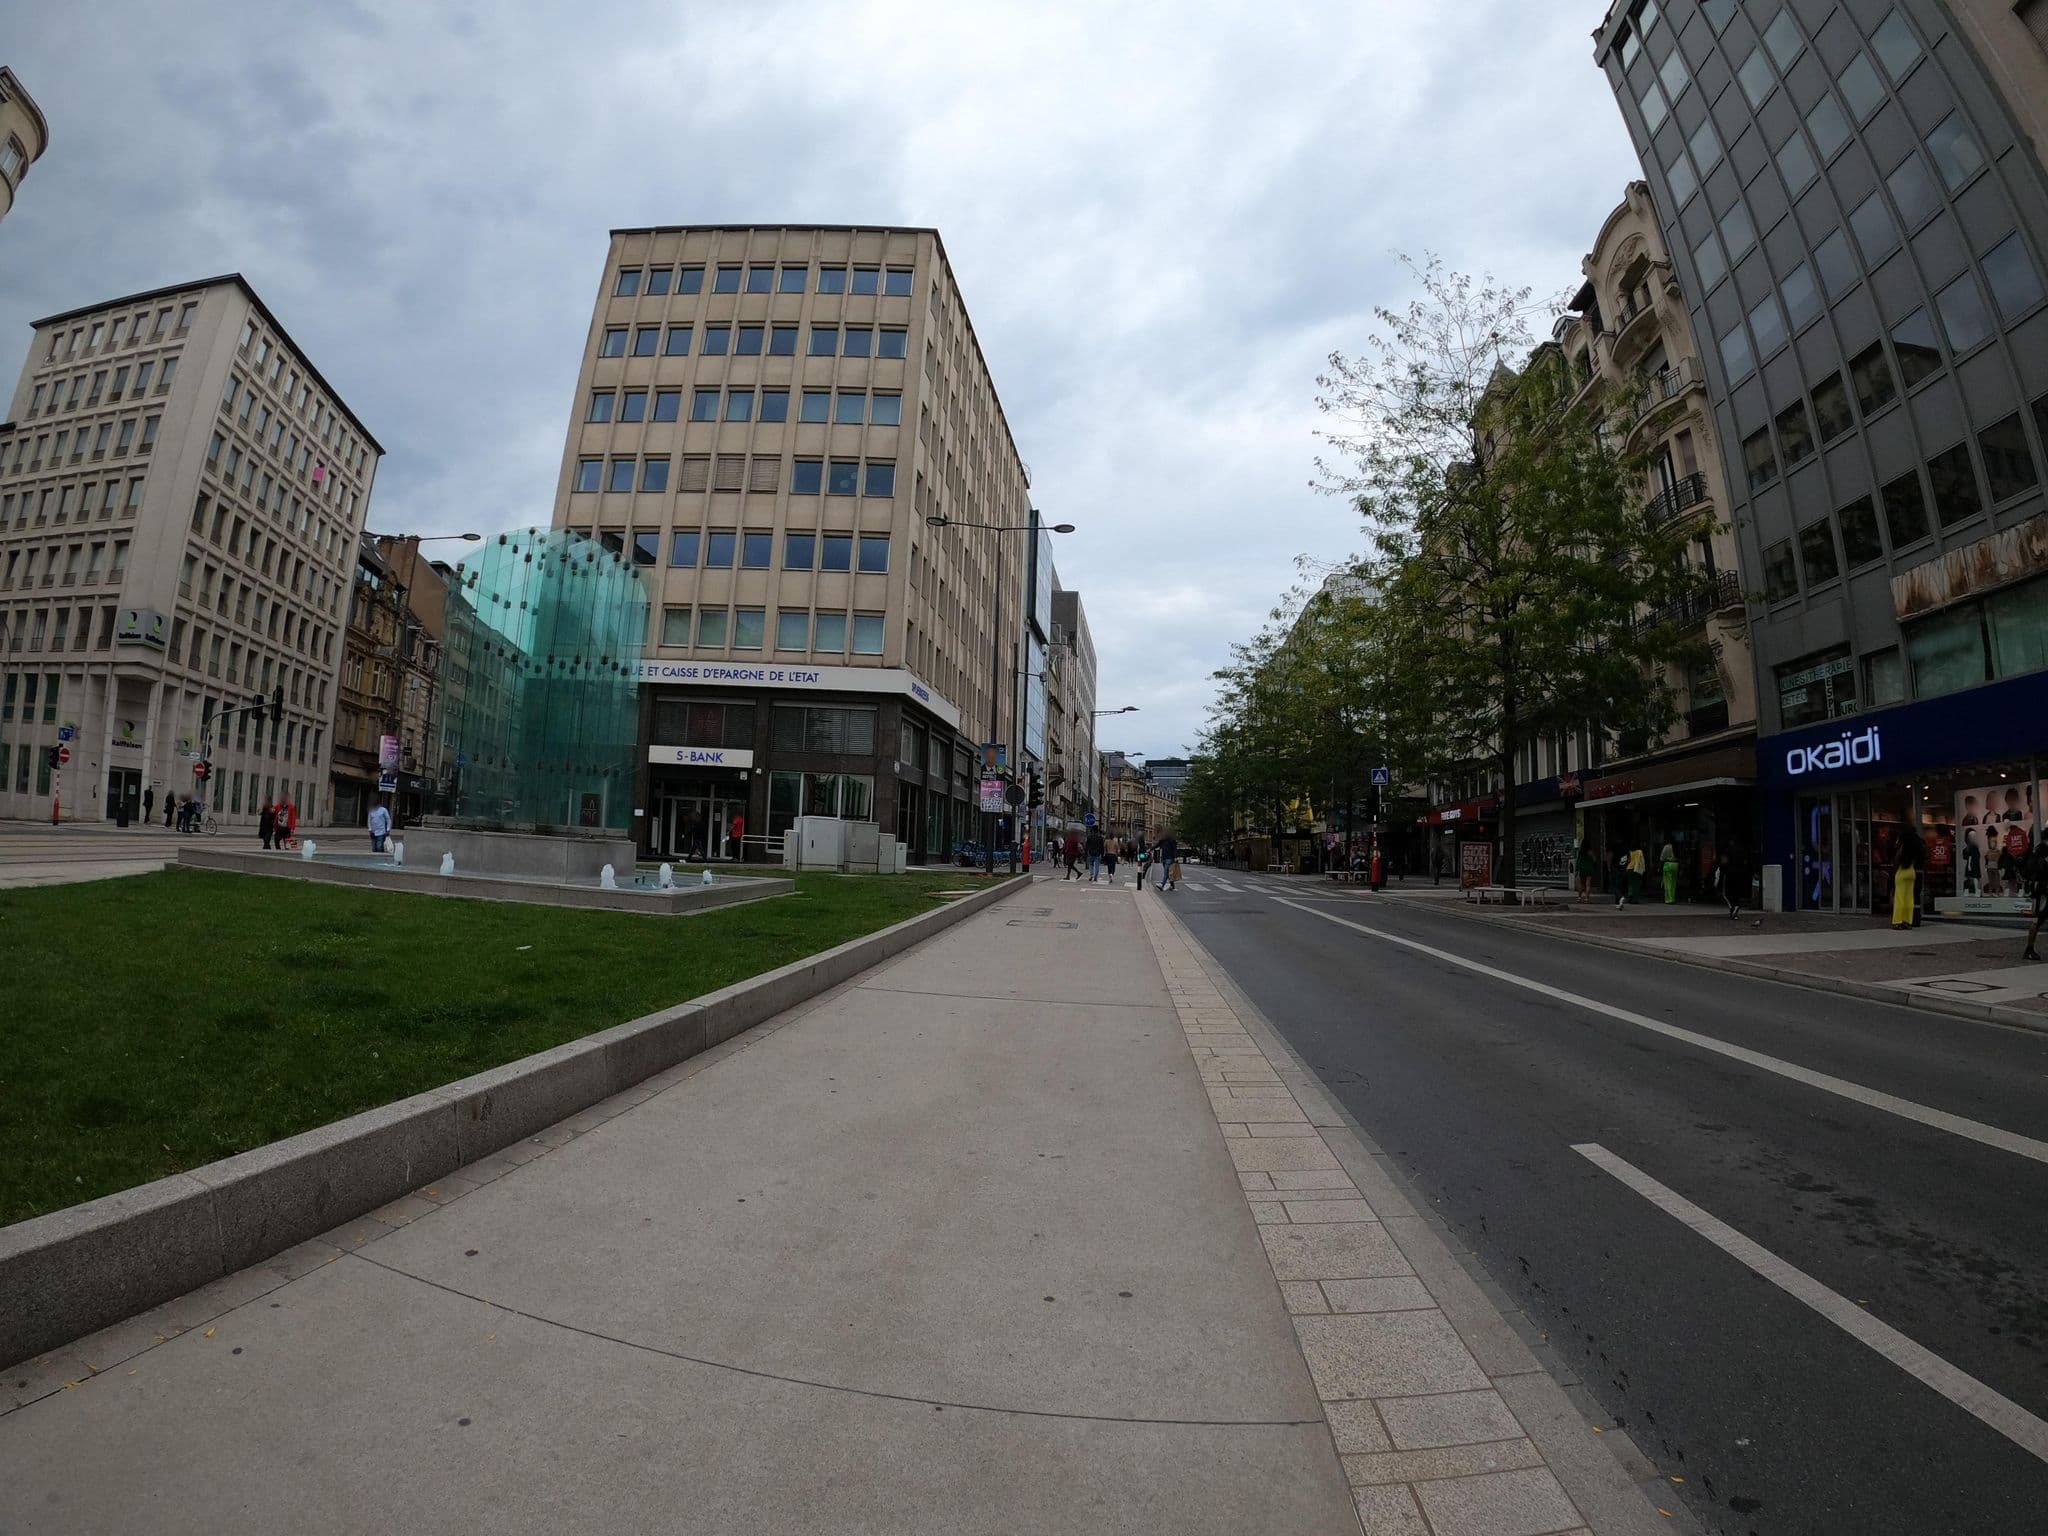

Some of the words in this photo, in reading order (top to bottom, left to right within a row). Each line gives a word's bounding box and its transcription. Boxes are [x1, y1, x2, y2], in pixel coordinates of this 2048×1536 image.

[647, 666, 660, 676] ET
[662, 667, 699, 678] CAISSE
[703, 667, 764, 681] D'EPARGNE
[769, 670, 784, 682] DE
[788, 671, 820, 683] L'ETAT
